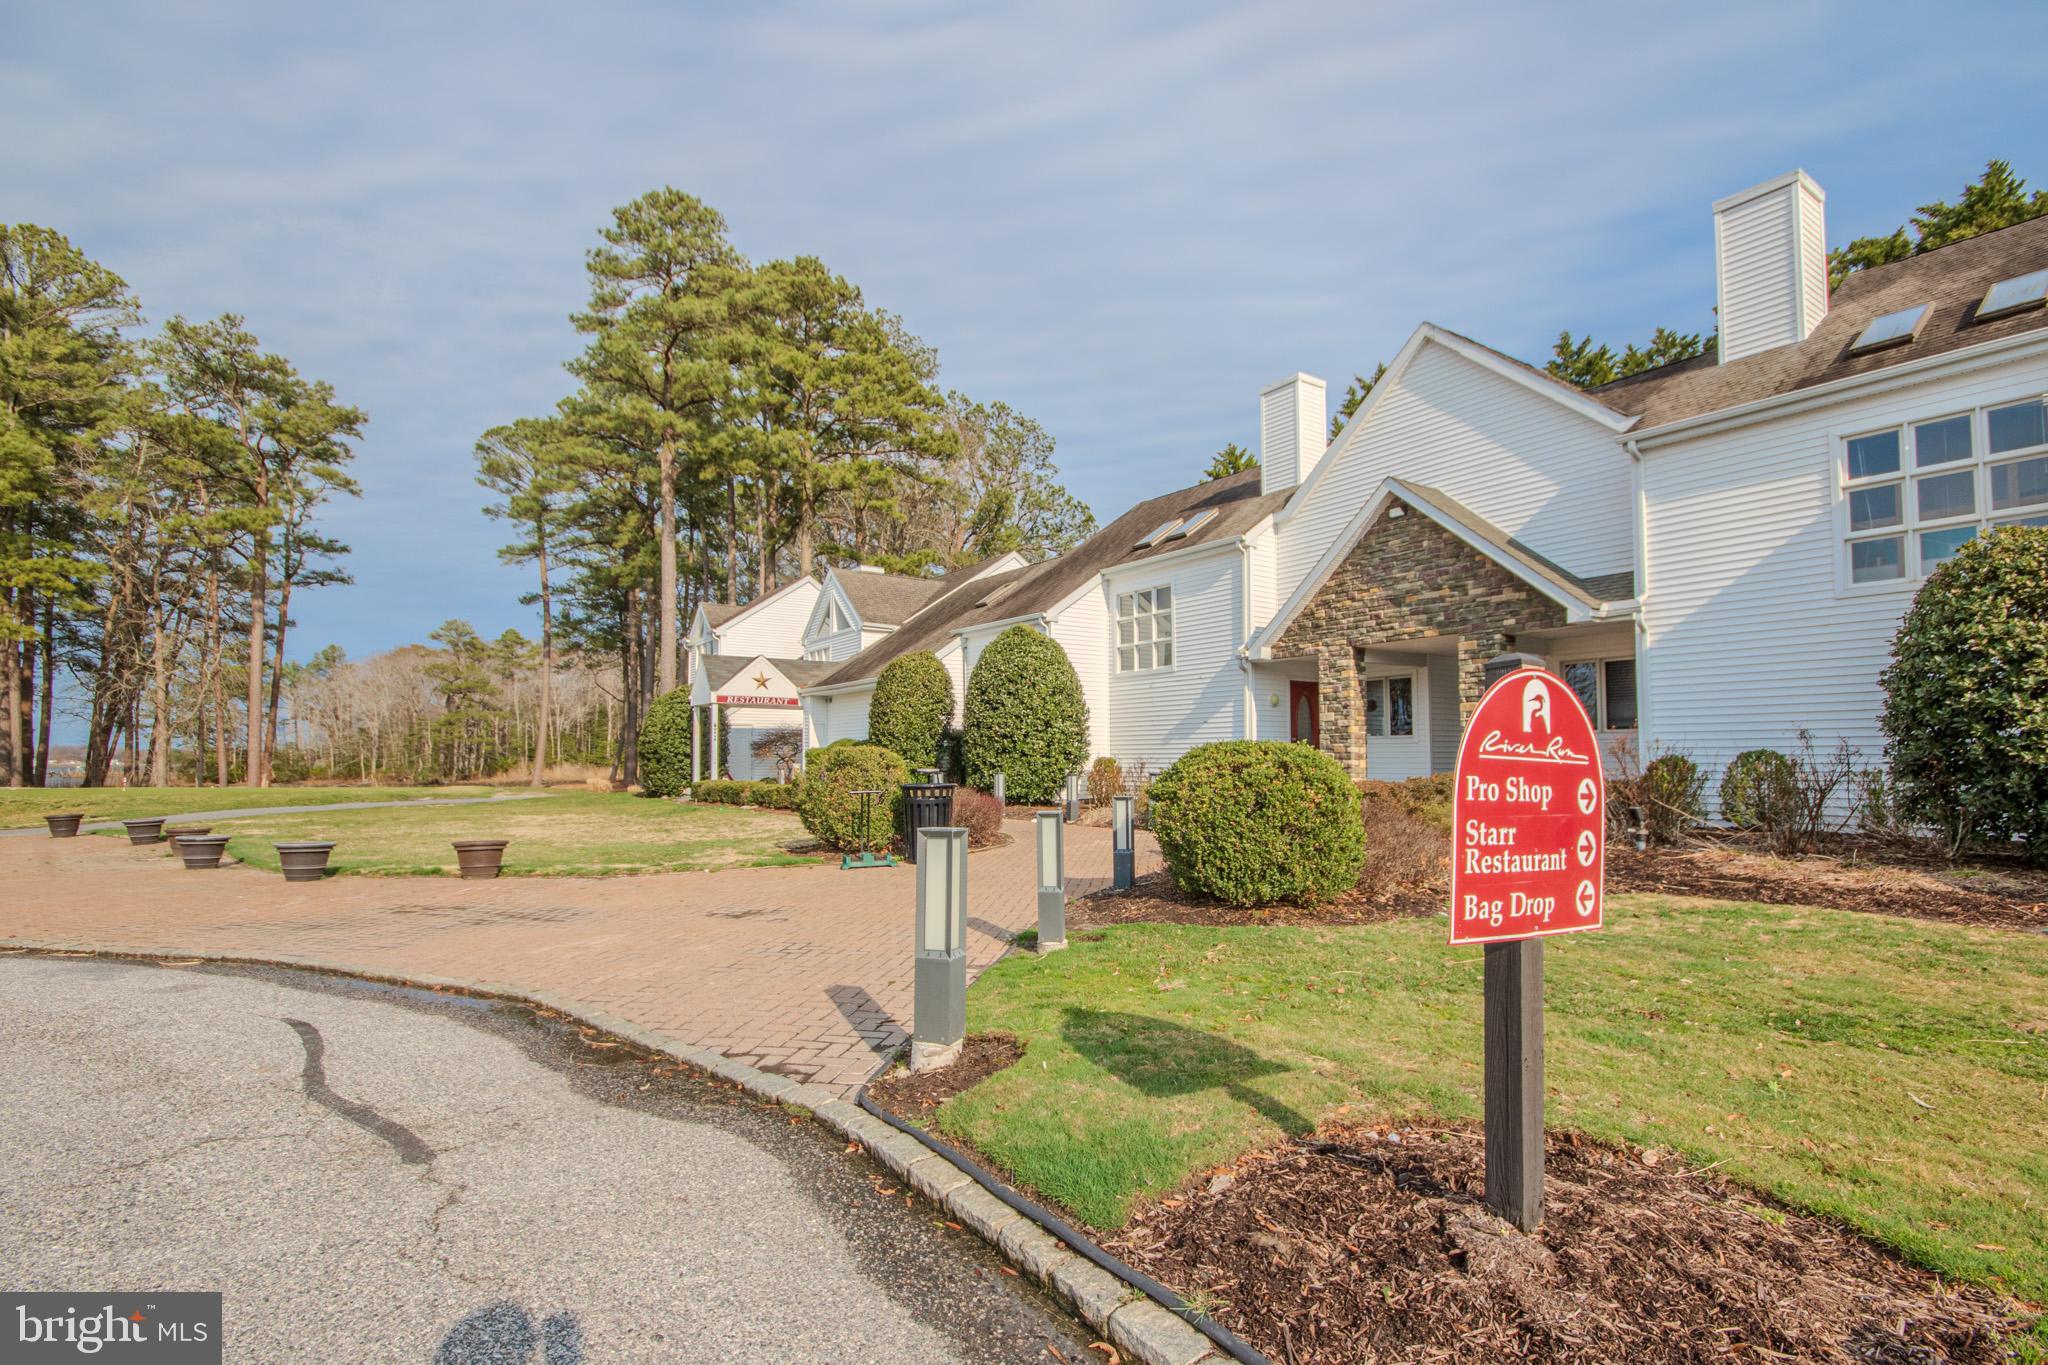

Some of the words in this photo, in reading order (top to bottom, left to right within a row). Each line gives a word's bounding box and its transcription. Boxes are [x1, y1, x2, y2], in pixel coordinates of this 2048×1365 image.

[727, 695, 789, 705] RESTAURANT
[1479, 730, 1544, 754] River
[1466, 775, 1500, 802] Pro
[1506, 777, 1553, 812] Shop
[1465, 819, 1517, 846] Starr
[1464, 848, 1568, 875] Restaurant
[1464, 894, 1504, 927] Bag
[1510, 892, 1556, 923] Drop
